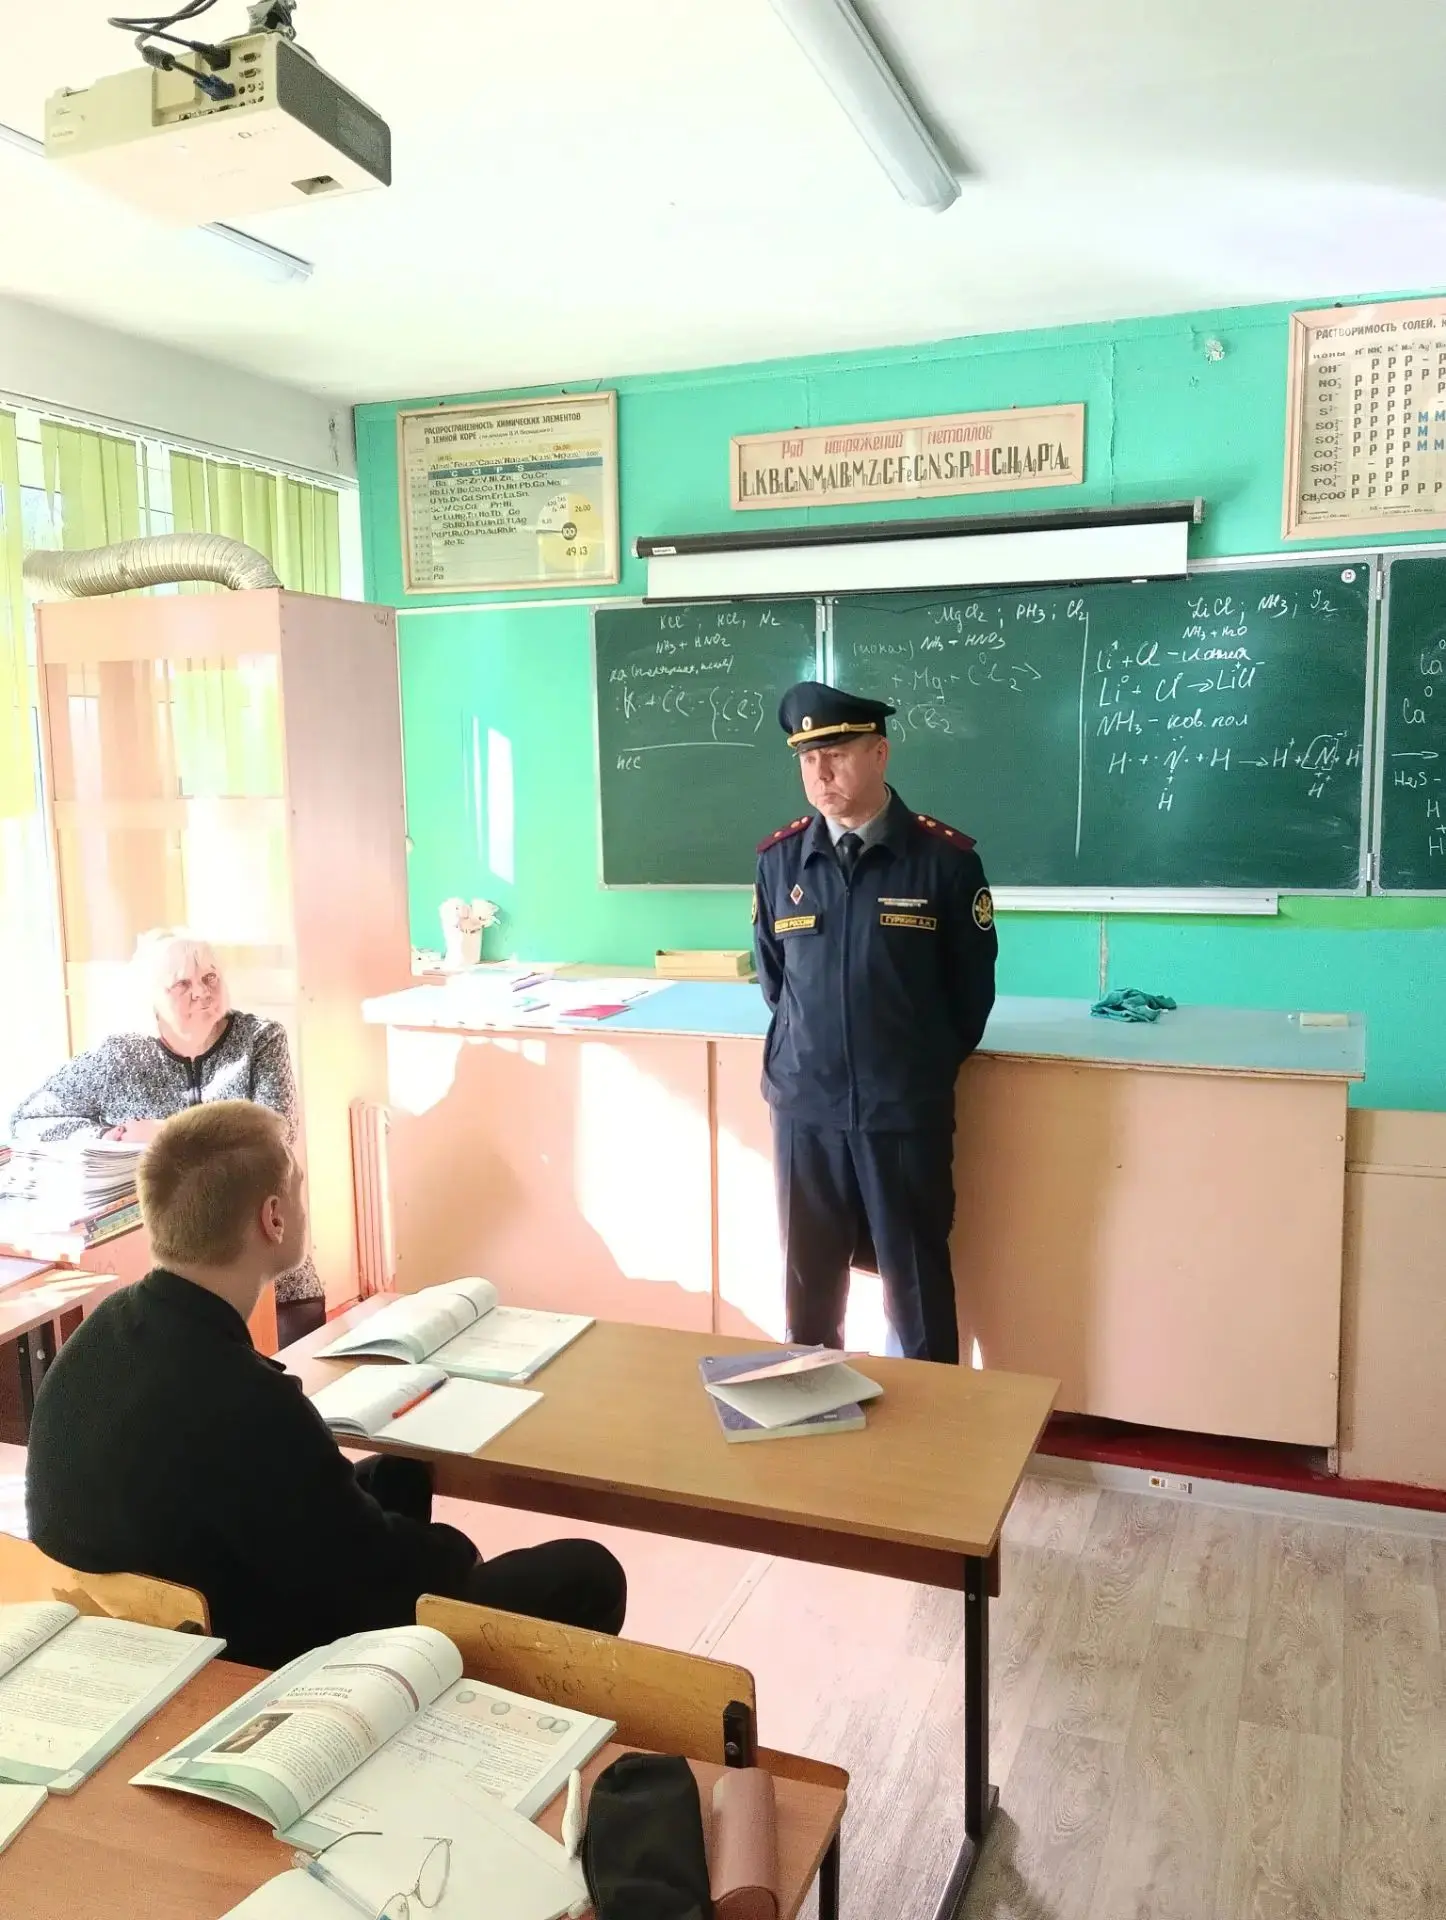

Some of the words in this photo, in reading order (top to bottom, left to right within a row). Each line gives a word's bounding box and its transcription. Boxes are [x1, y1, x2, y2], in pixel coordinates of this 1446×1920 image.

[1316, 323, 1397, 340] РАСТВОРИМОСТЬ
[496, 416, 540, 428] ХИМИЧЕСКИХ
[460, 431, 476, 441] КОРЕ
[825, 432, 904, 457] напряжений
[927, 425, 993, 445] металлов
